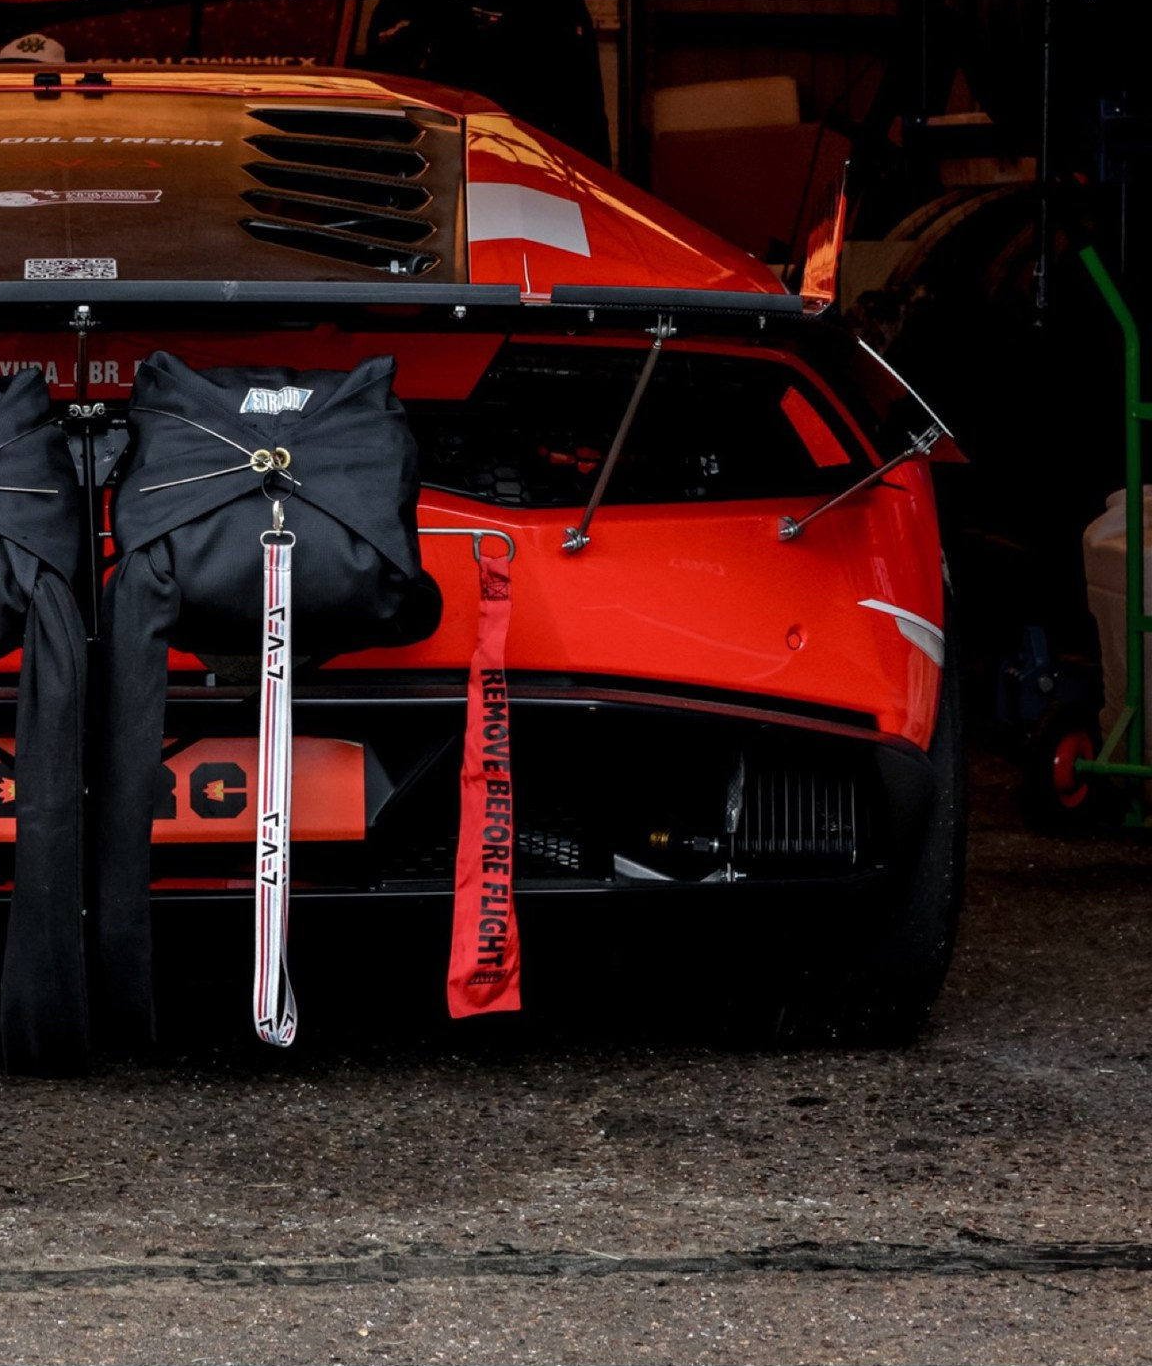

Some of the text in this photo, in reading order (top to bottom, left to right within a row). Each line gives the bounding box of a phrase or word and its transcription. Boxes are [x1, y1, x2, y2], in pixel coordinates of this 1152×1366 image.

[477, 669, 511, 968] REMOVE BEFORE FLIGHT
